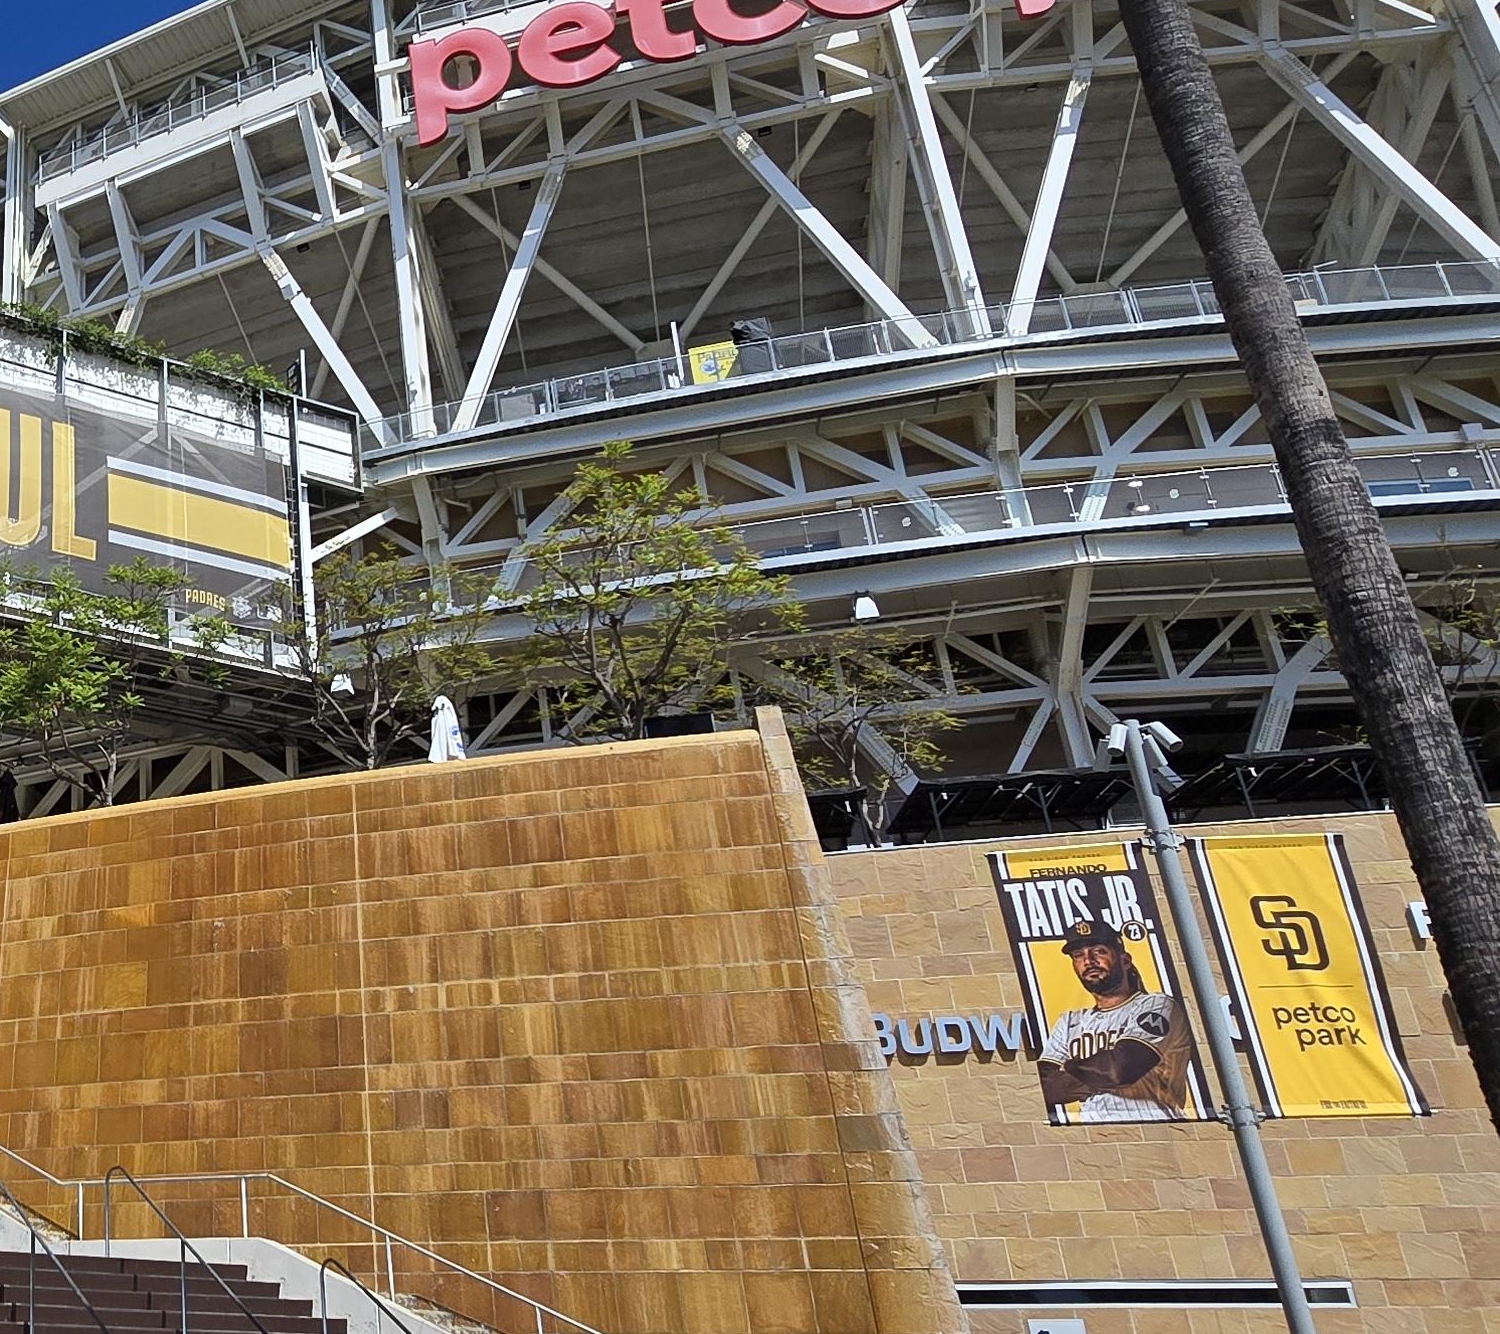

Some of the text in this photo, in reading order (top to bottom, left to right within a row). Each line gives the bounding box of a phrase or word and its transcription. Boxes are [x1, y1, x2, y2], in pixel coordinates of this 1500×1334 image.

[185, 588, 227, 612] PADRES
[1029, 863, 1108, 878] FERNANDO
[1002, 874, 1155, 938] TATIS JR.
[1272, 1001, 1357, 1030] petco
[1294, 1024, 1368, 1052] park
